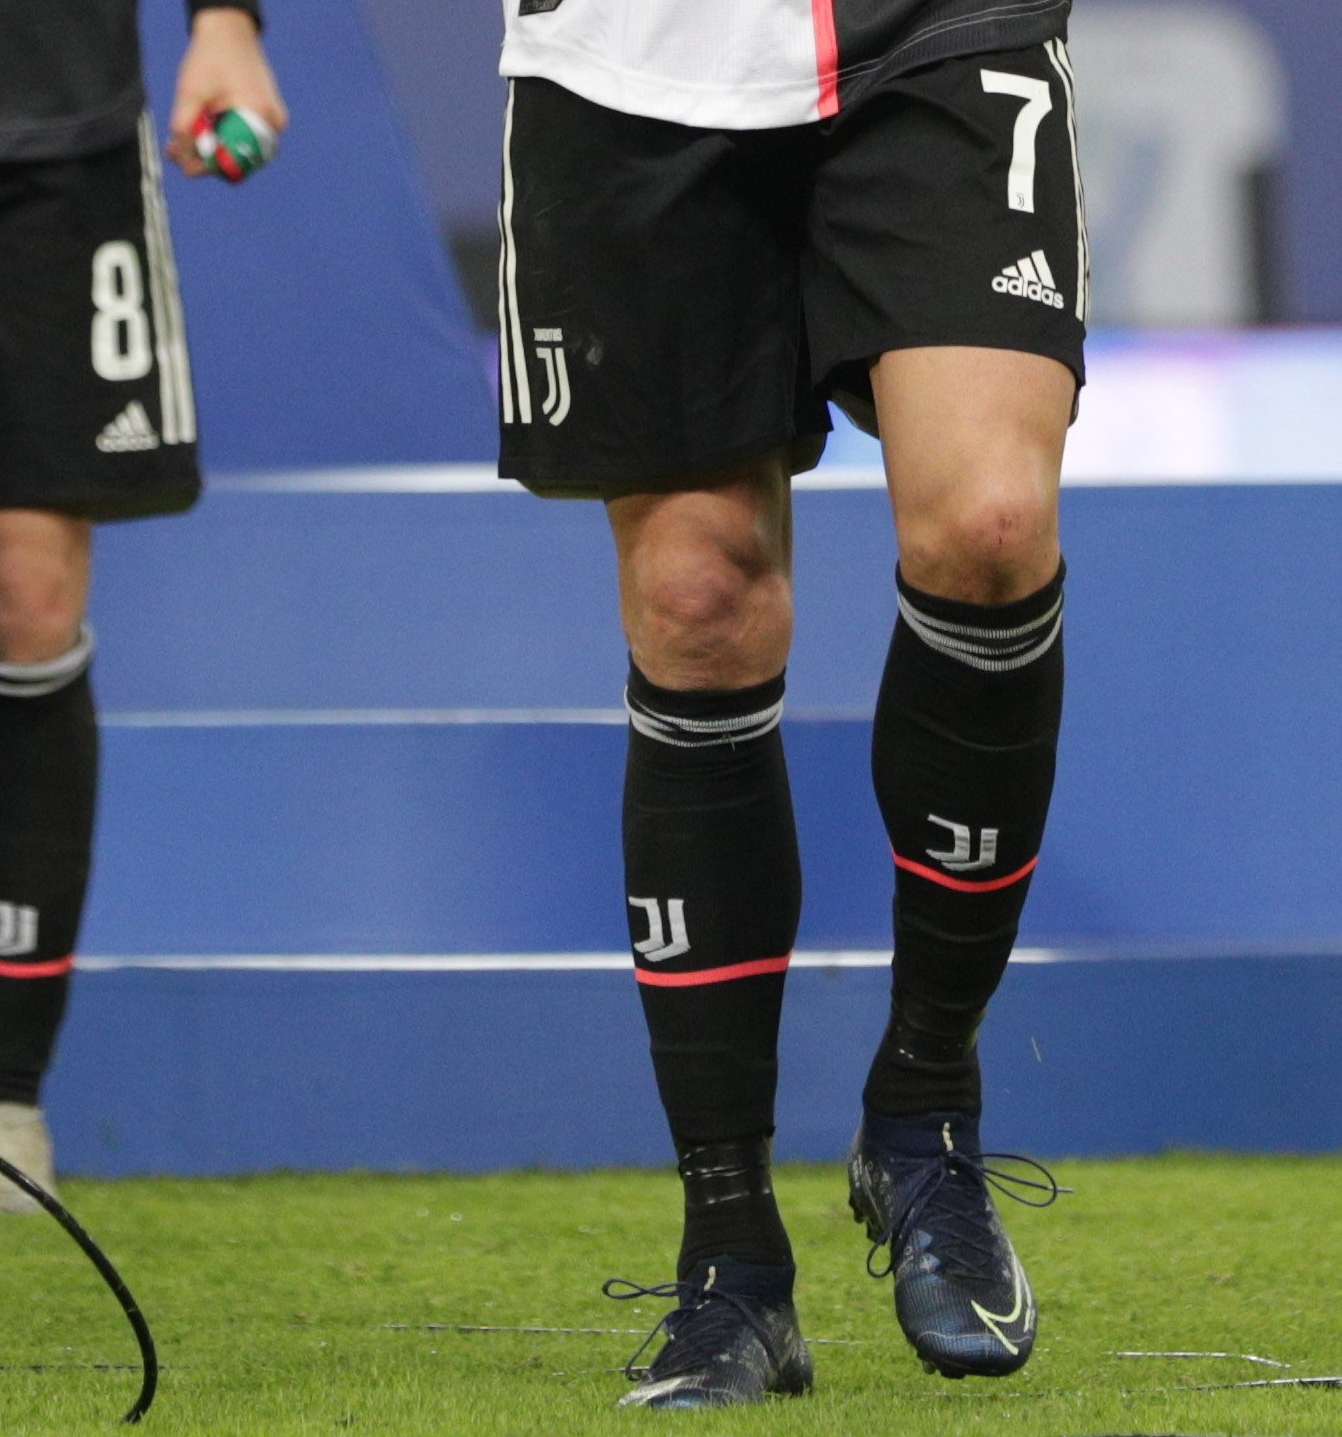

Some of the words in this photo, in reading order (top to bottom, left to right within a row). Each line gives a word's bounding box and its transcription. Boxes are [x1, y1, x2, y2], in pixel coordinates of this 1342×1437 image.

[980, 68, 1053, 214] 7
[90, 239, 153, 382] 8
[991, 274, 1065, 310] adidas
